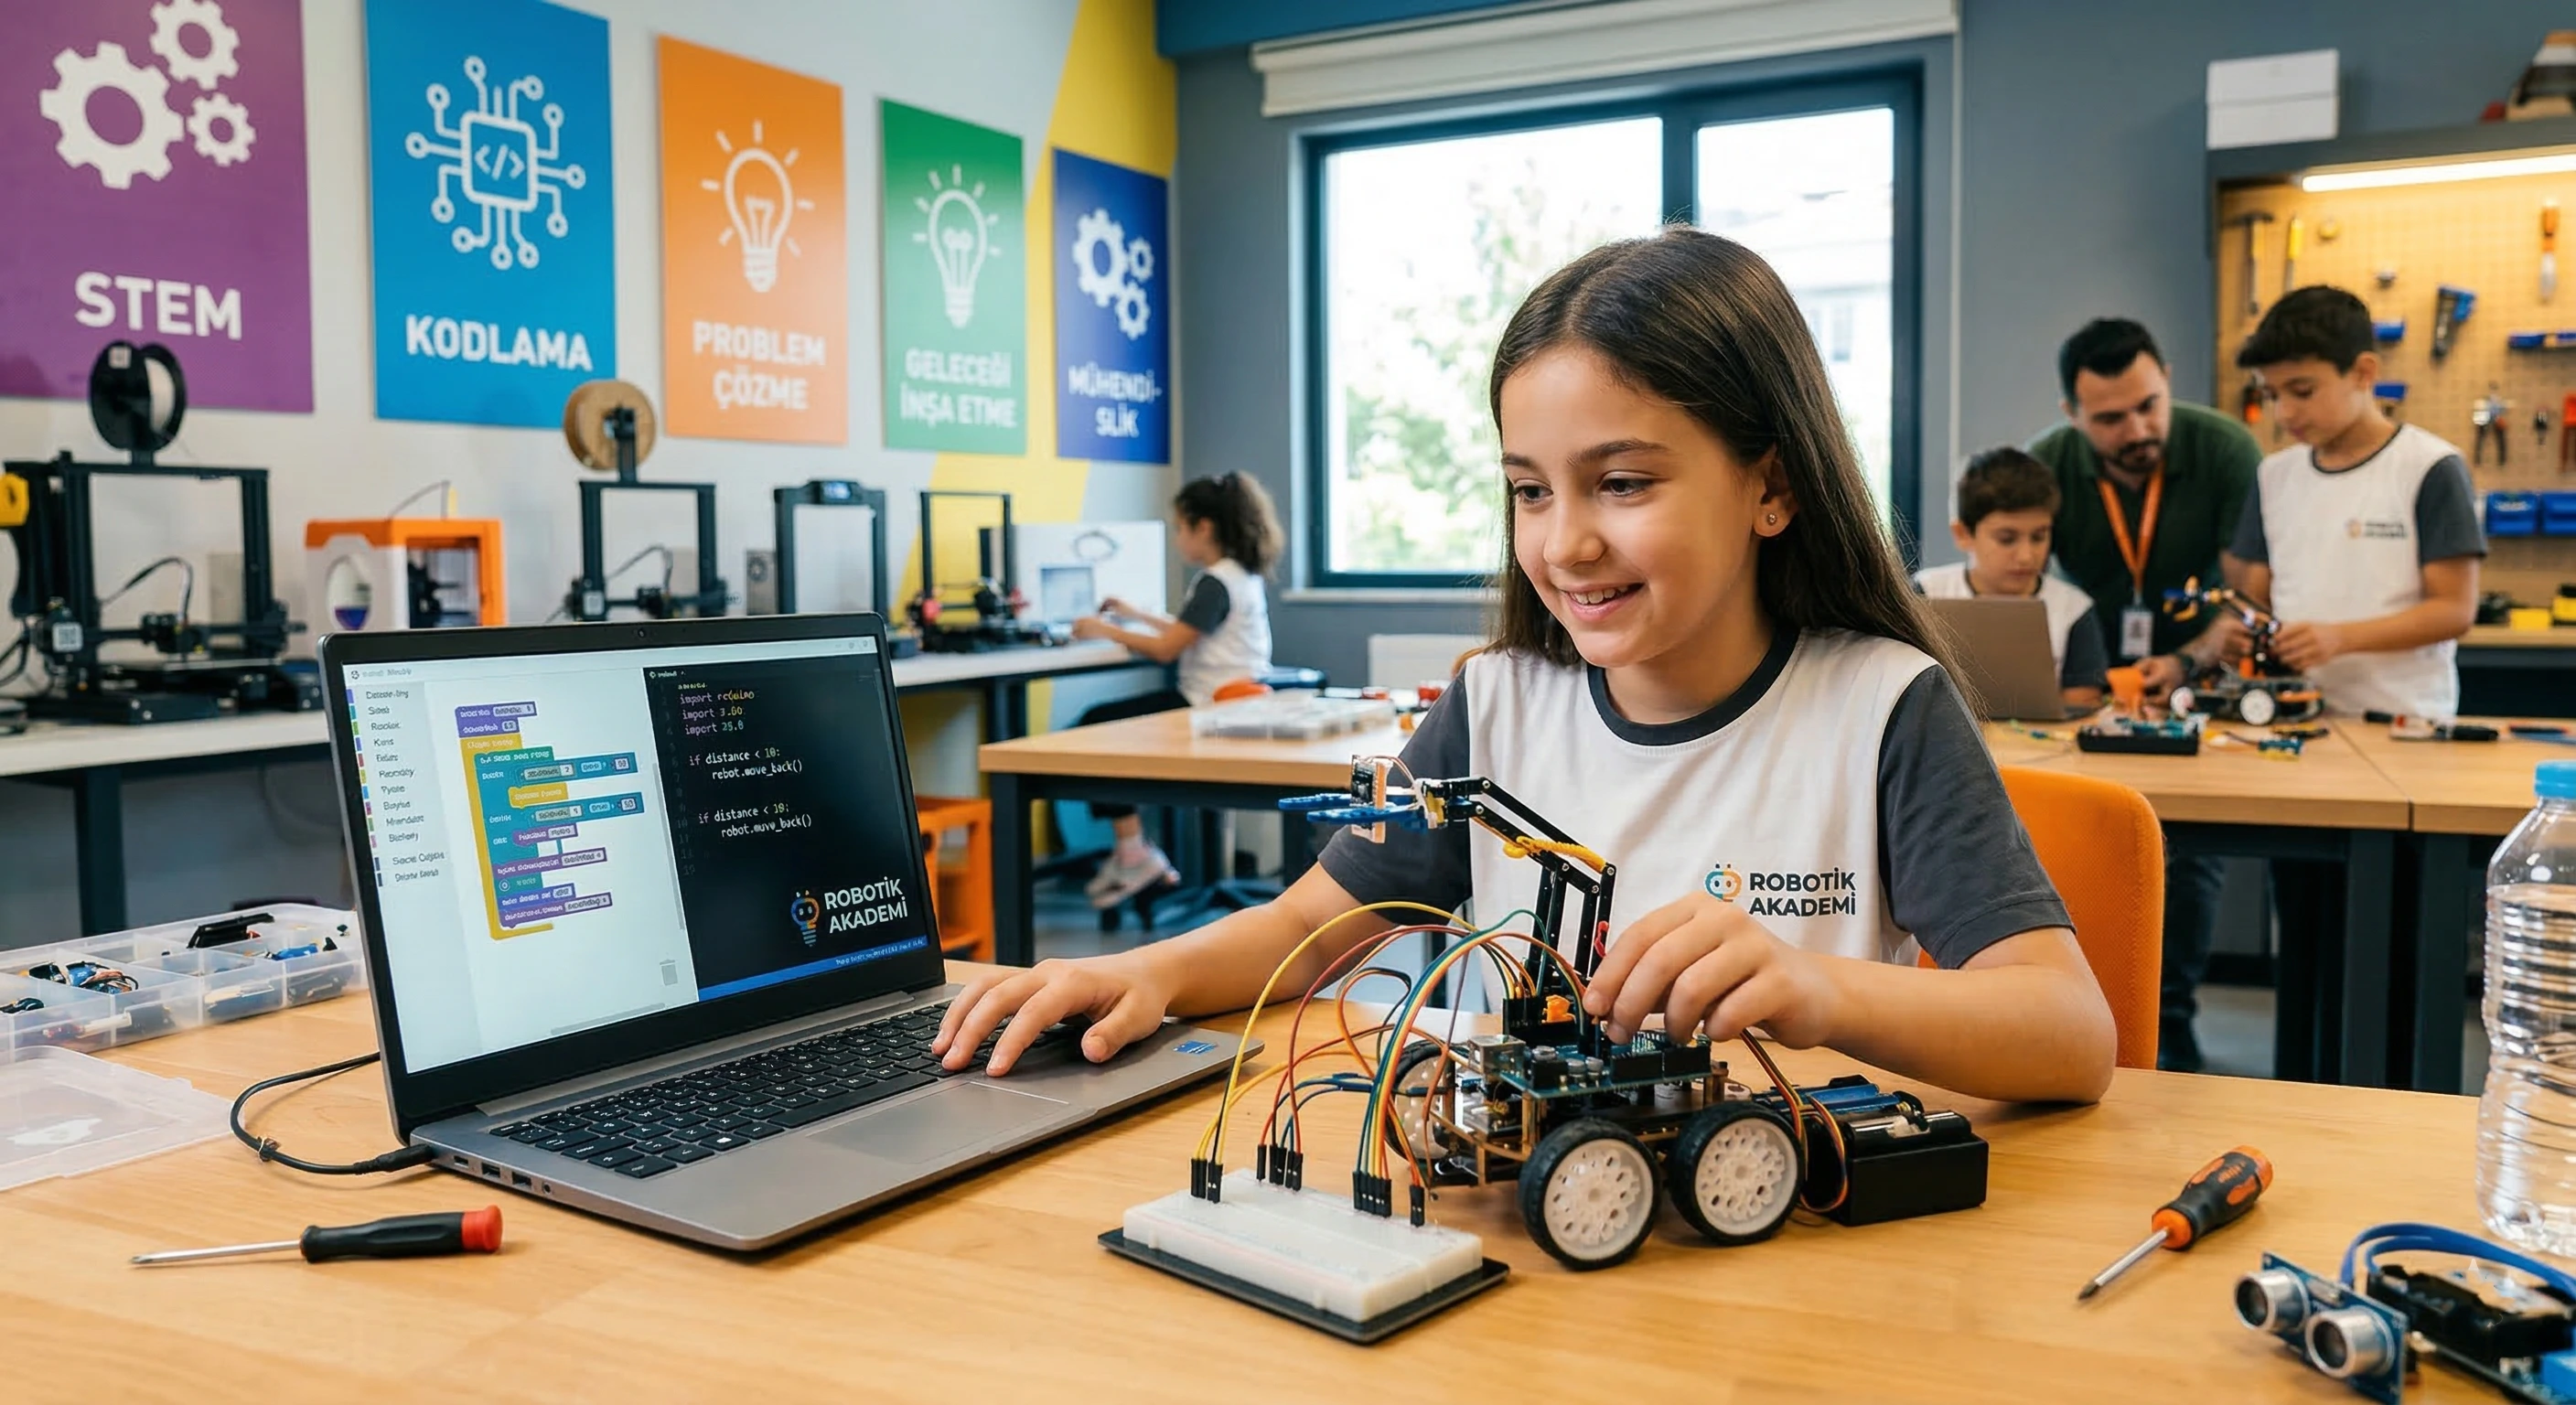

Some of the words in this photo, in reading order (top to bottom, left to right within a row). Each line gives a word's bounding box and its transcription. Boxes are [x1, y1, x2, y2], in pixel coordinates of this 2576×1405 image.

[74, 271, 242, 341] STEM
[405, 313, 594, 372] KODLAMA
[692, 320, 825, 366] PROBLEM
[713, 364, 809, 411] ÇÖZME
[900, 382, 954, 428] İNŞA
[958, 393, 1017, 428] ETME
[690, 755, 701, 766] if
[705, 751, 750, 765] distance
[699, 812, 709, 823] if
[714, 807, 759, 822] distance
[824, 876, 904, 910] ROBOTİK
[1749, 867, 1856, 893] ROBOTİK
[829, 896, 908, 934] AKADEMİ
[1748, 892, 1856, 917] AKADEMİ
